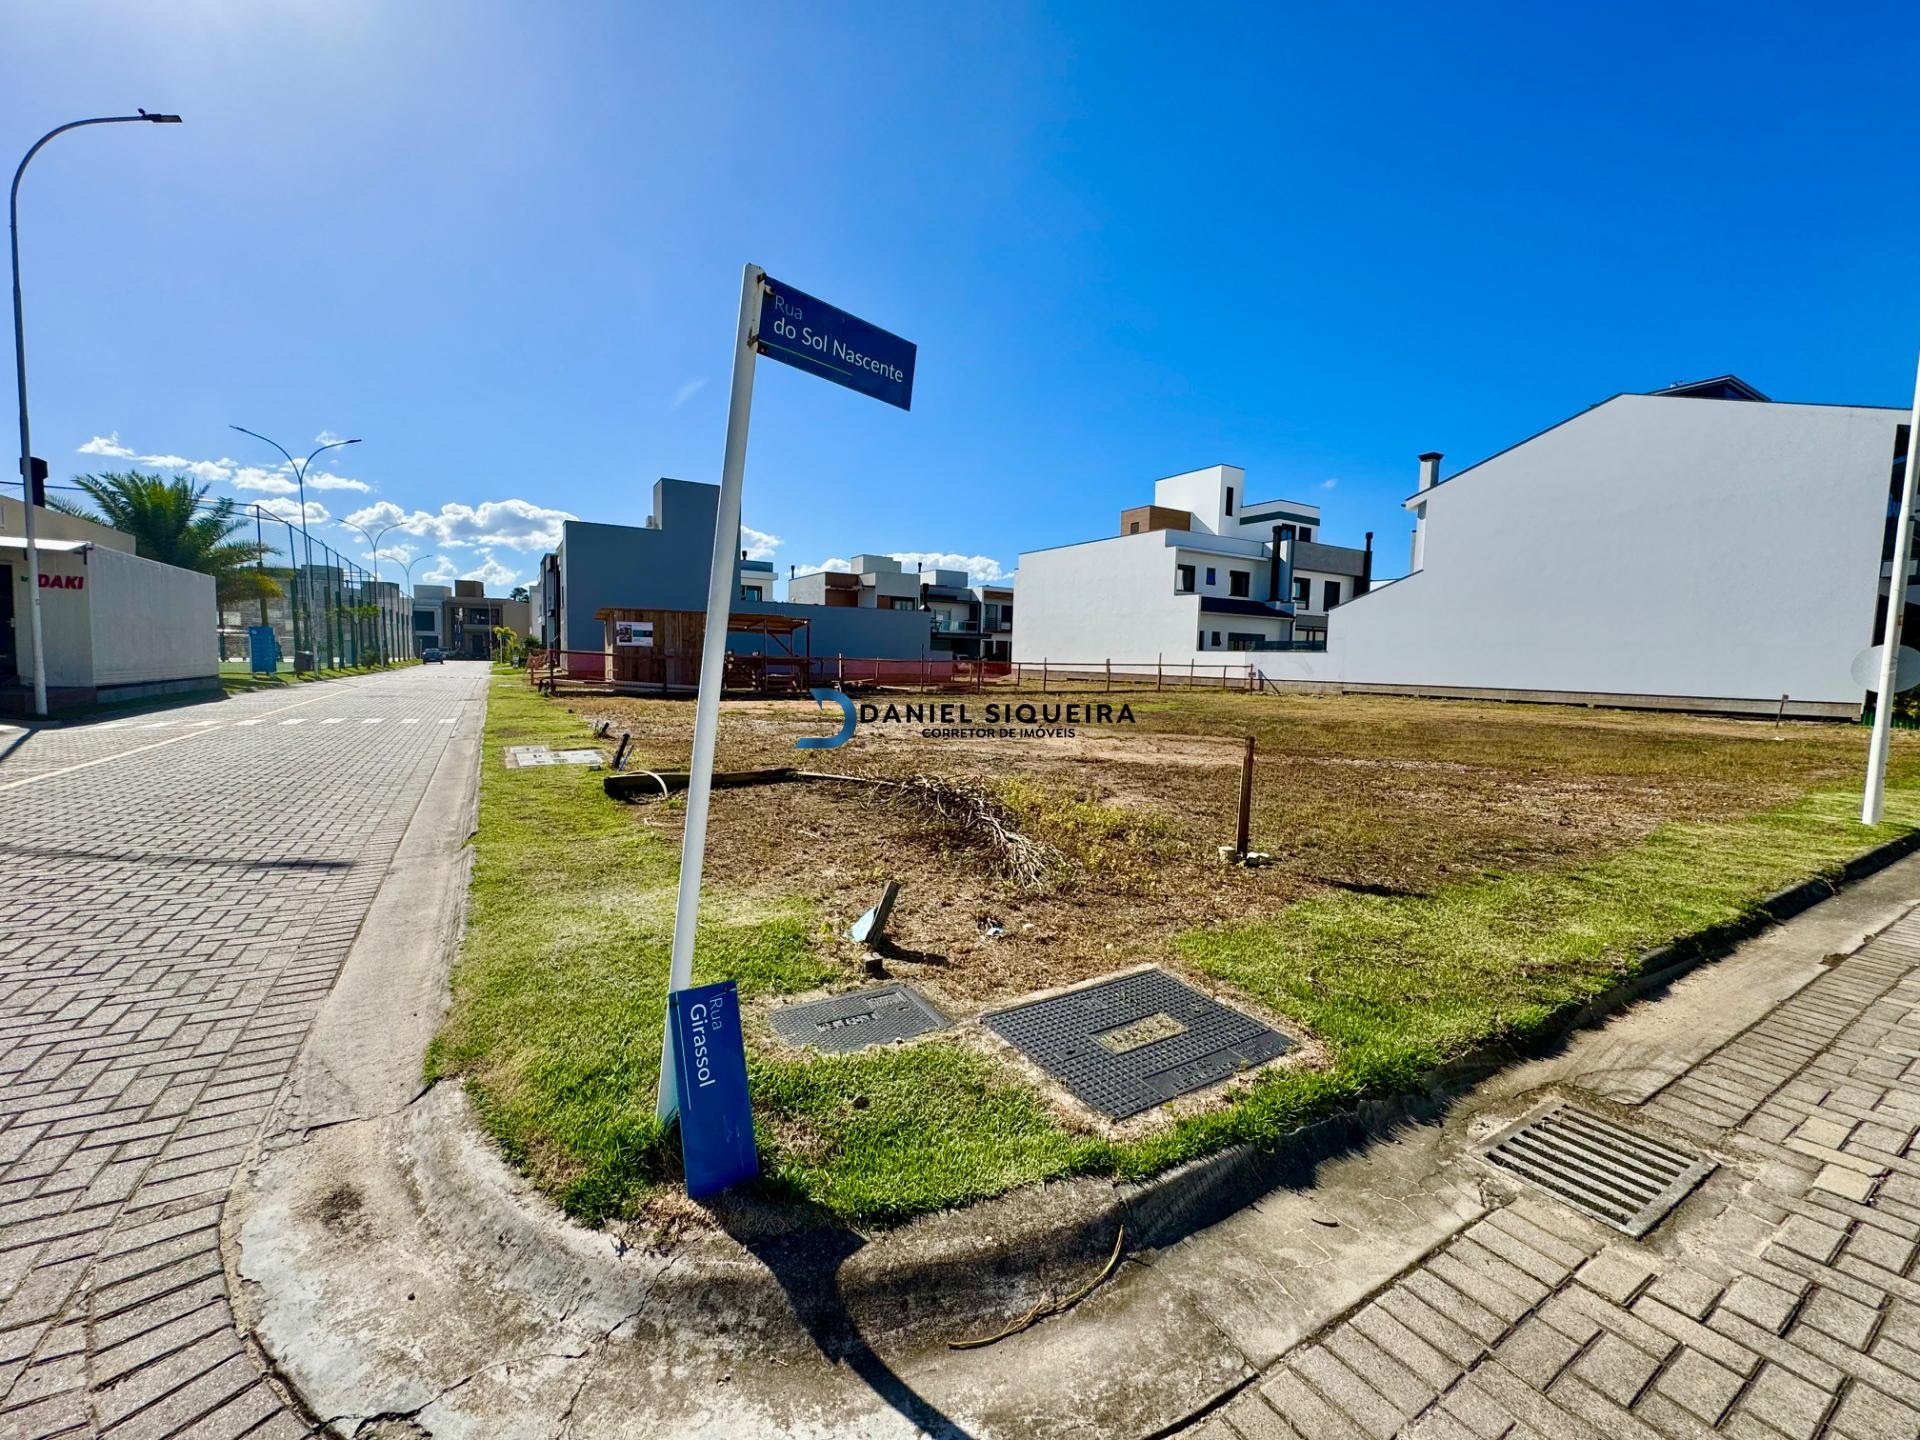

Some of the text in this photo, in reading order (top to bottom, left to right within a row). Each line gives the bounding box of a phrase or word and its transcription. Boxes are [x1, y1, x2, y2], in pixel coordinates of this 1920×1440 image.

[774, 294, 803, 320] Rua
[773, 317, 904, 383] do Sol Nascente
[38, 573, 84, 590] DAKI
[709, 997, 723, 1031] Rua
[690, 1003, 716, 1087] Girassol
